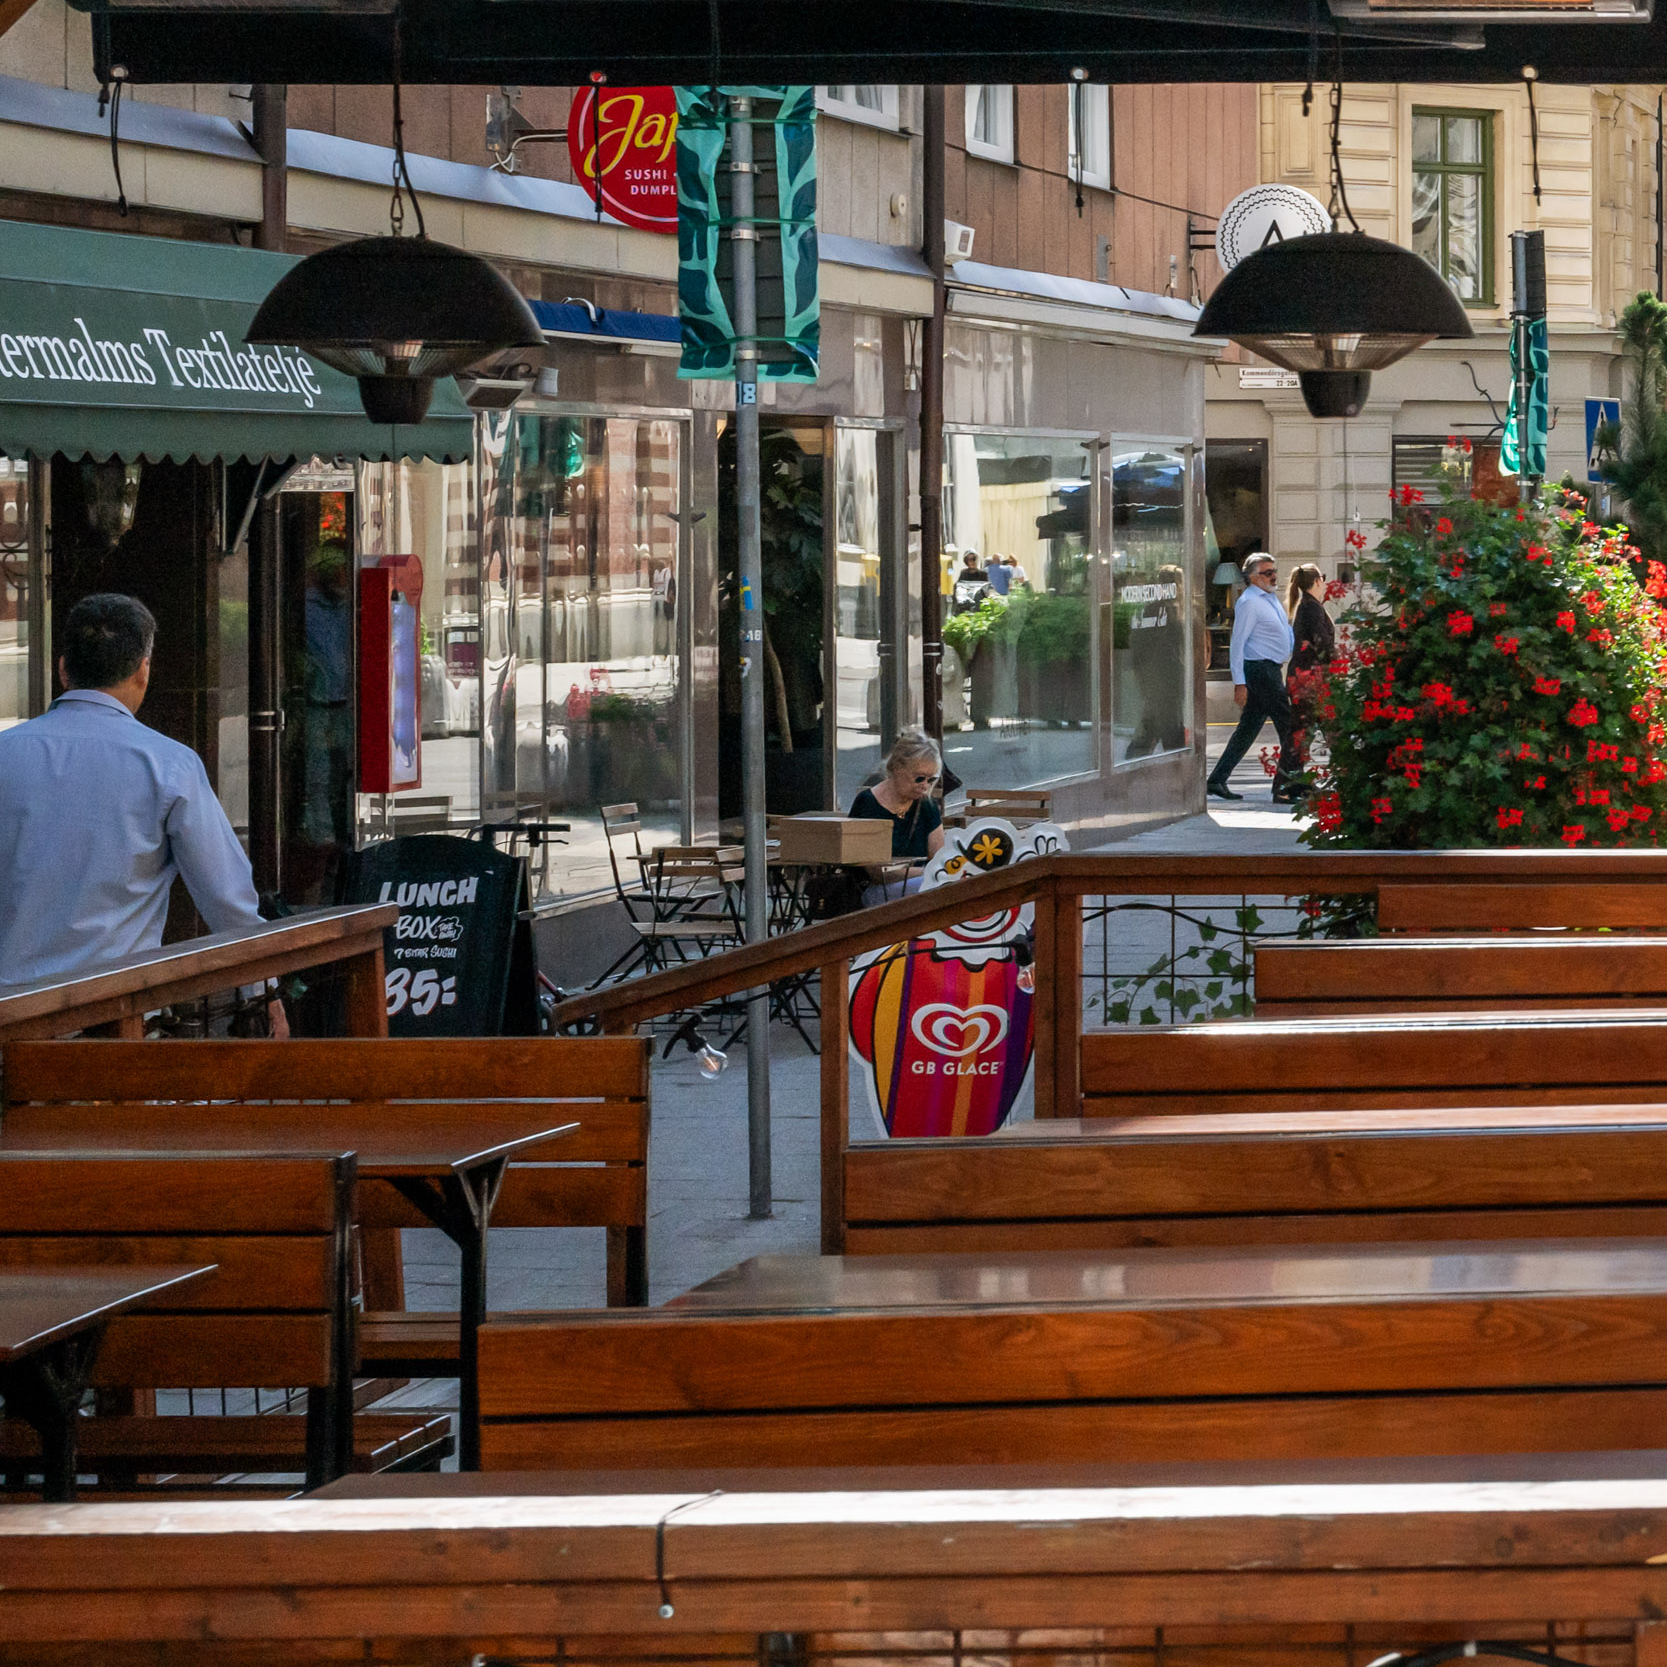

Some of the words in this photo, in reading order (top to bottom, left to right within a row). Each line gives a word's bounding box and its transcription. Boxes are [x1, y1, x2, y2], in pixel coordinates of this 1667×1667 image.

[624, 169, 667, 180] SUSHI
[379, 876, 479, 908] LUNCH
[393, 914, 441, 940] BOX
[394, 947, 404, 959] 7
[430, 944, 457, 958] SUSHI
[911, 1060, 936, 1075] GB
[942, 1061, 999, 1076] GLACE
